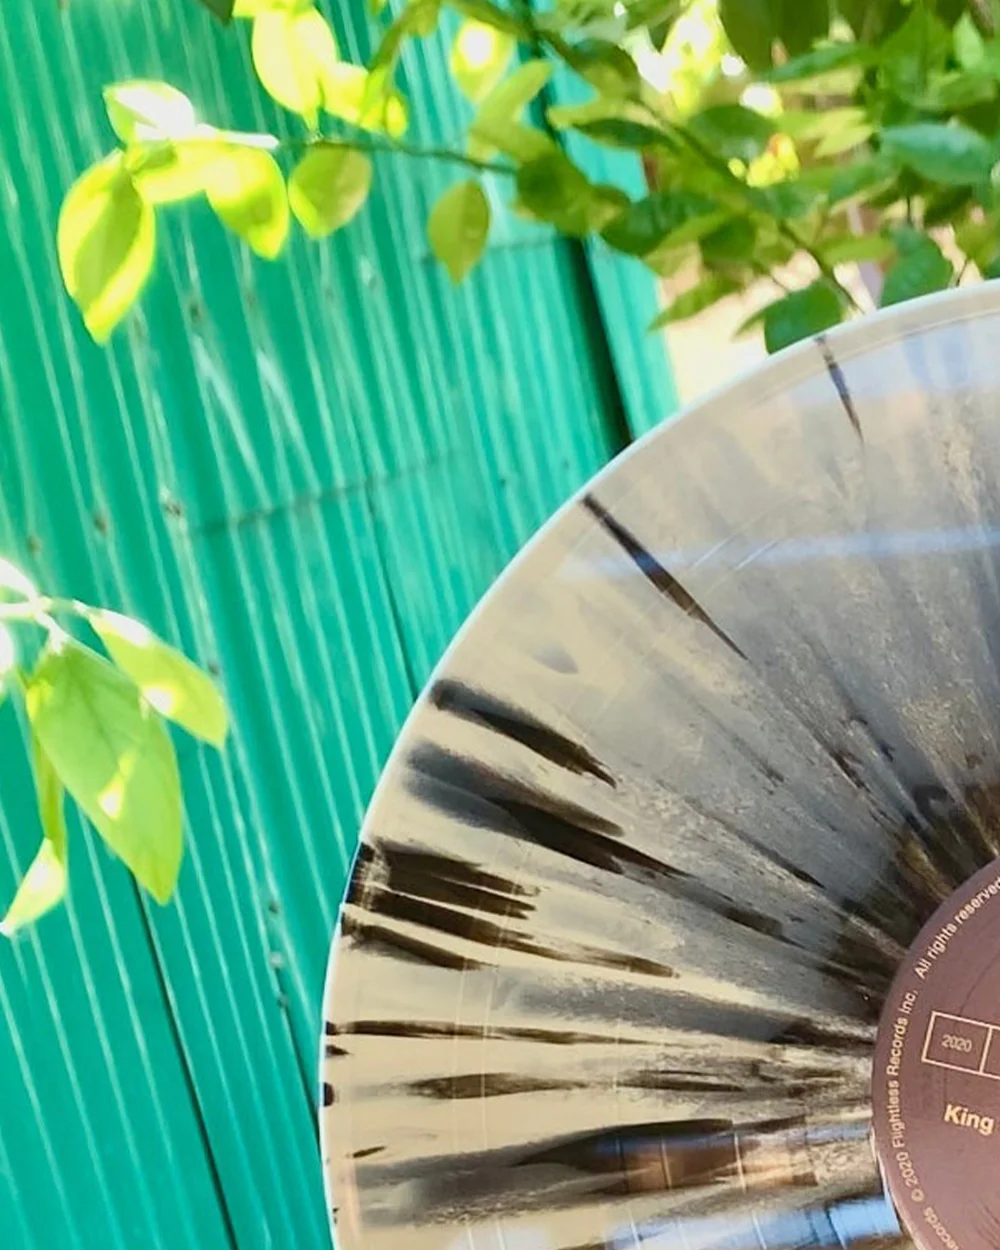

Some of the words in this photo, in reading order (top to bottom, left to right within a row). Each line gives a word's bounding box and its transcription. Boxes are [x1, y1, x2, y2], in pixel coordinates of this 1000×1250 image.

[928, 923, 957, 961] rights
[914, 958, 932, 980] All
[887, 1018, 909, 1077] Records
[941, 1034, 972, 1053] 2020
[888, 1080, 906, 1148] Flightless
[944, 1104, 994, 1135] King
[896, 1151, 919, 1187] 2020
